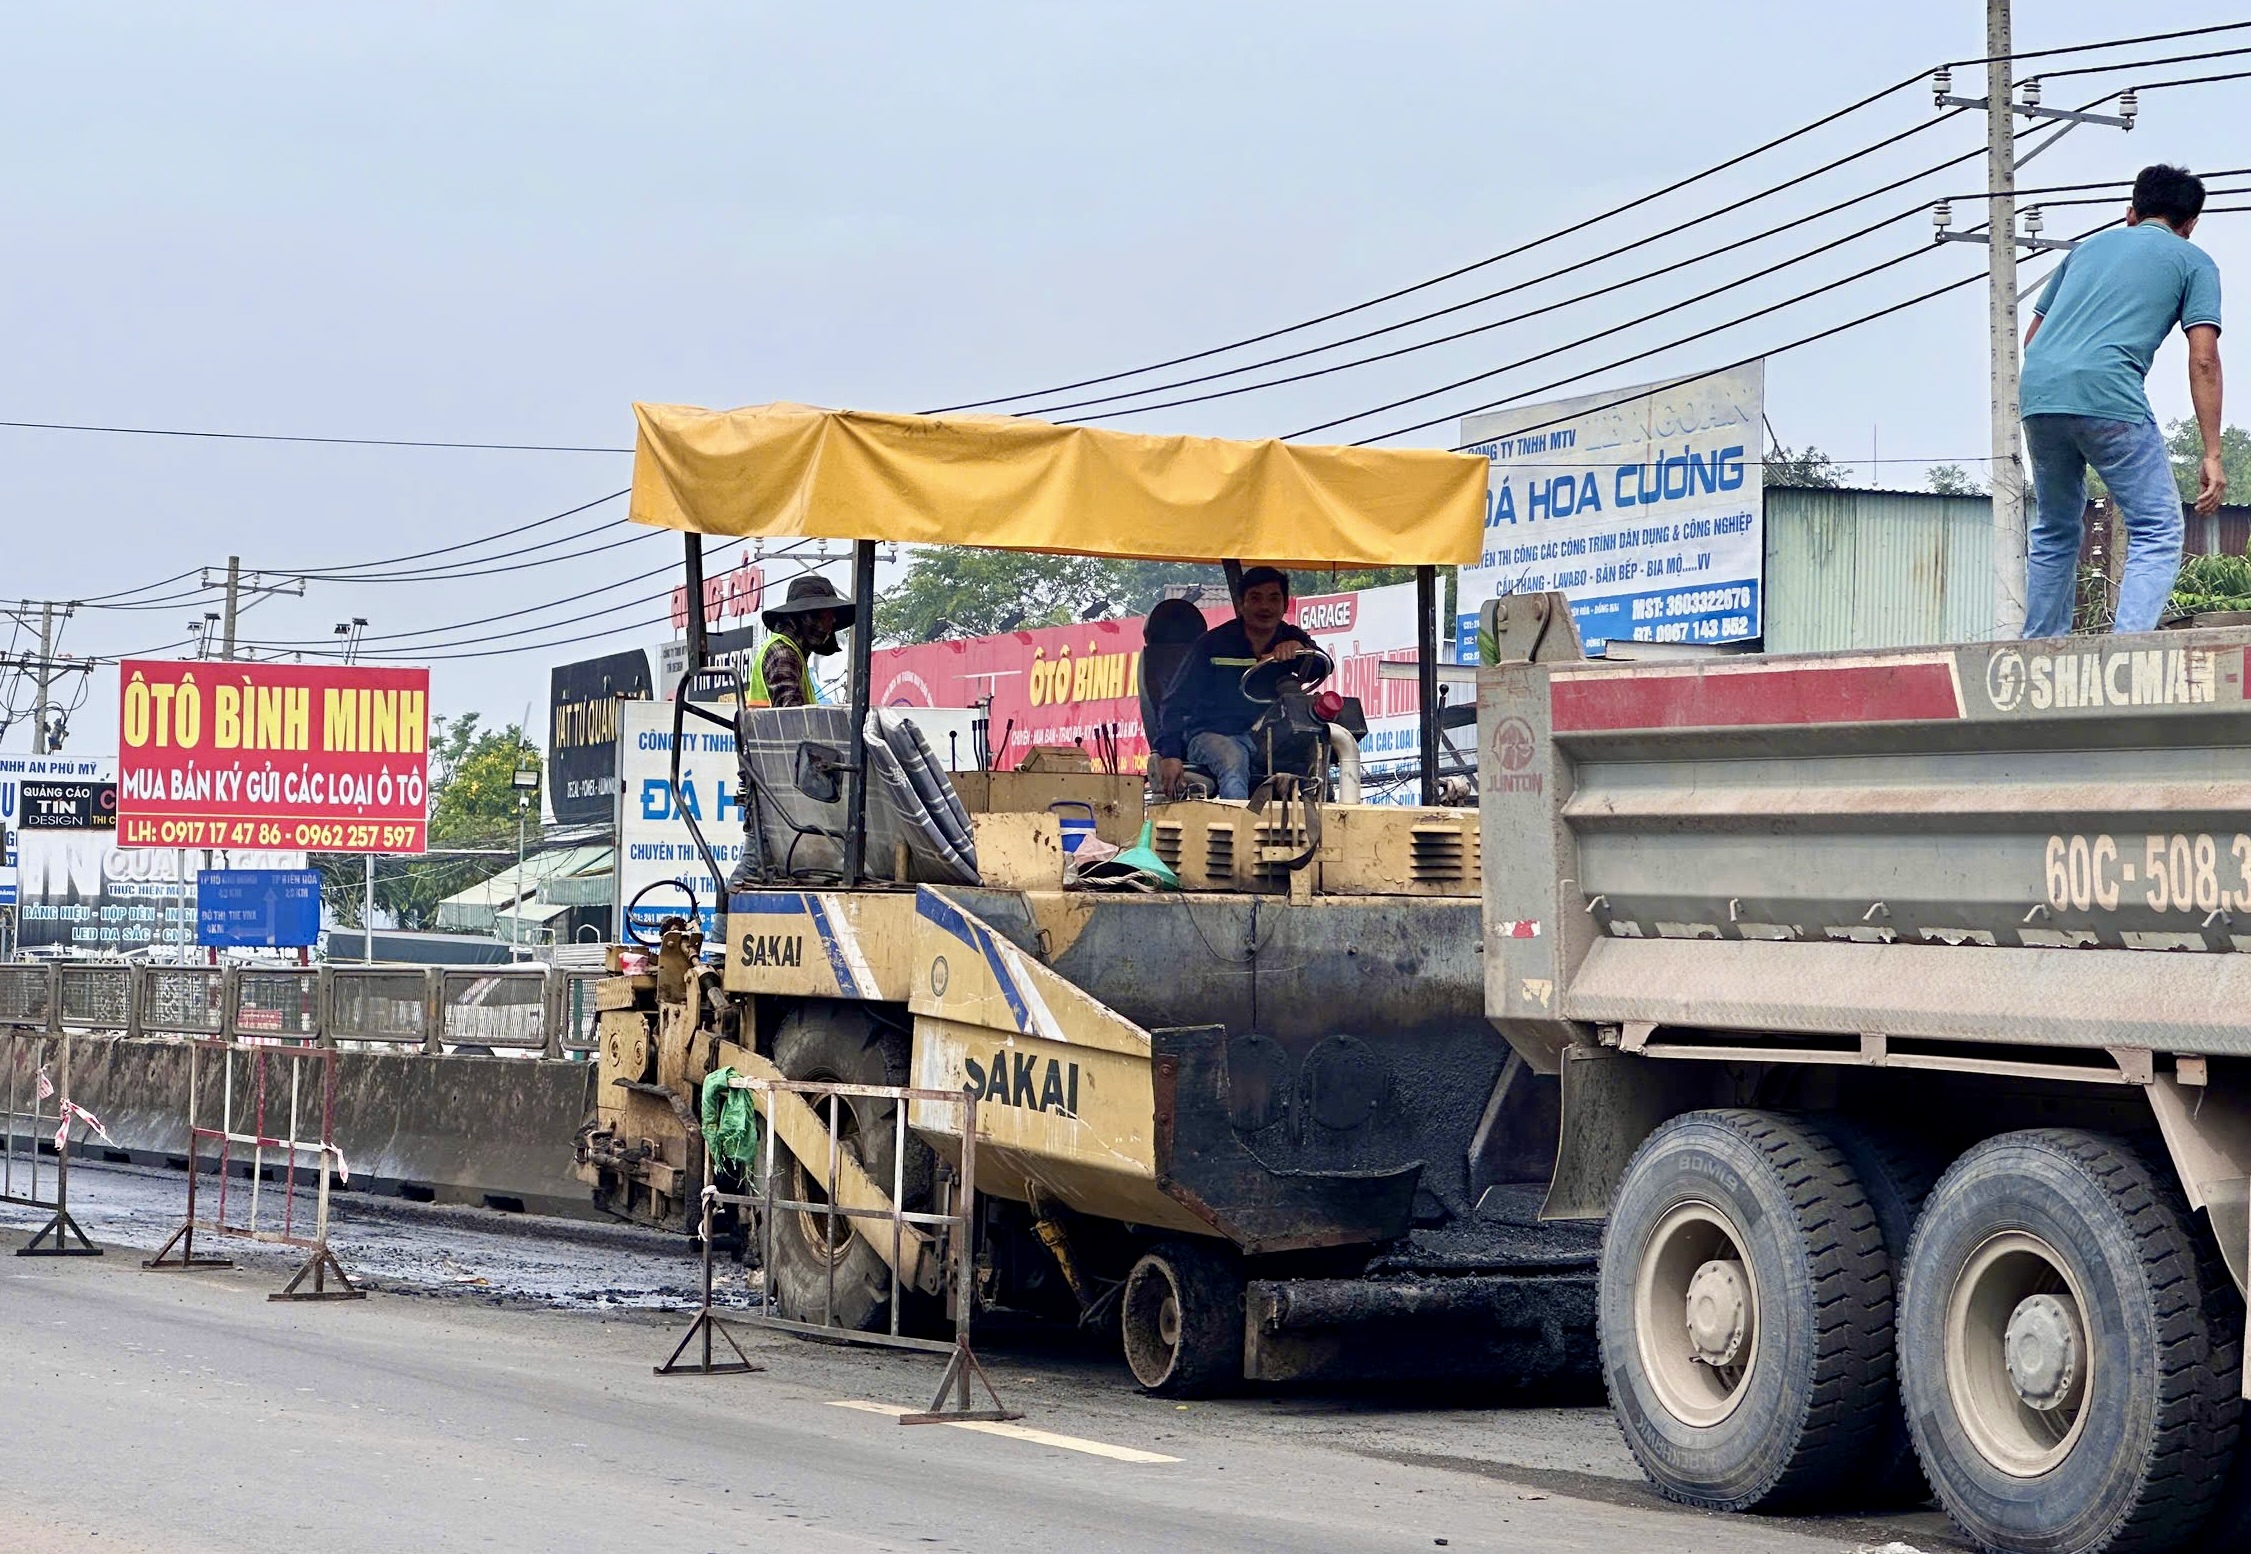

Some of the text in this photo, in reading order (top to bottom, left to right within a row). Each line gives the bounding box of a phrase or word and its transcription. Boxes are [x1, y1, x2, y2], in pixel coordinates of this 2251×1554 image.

[1501, 440, 1514, 459] TY
[1517, 434, 1547, 456] TNHH
[1550, 429, 1576, 450] MTV
[1528, 471, 1602, 522] HOA
[1615, 444, 1744, 508] CƯƠNG
[1498, 550, 1511, 566] THI
[1514, 544, 1538, 563] CÔNG
[1540, 540, 1558, 559] CÁC
[1561, 536, 1586, 557] CÔNG
[1588, 532, 1617, 553] TRÌNH
[1619, 528, 1640, 547] DÂN
[1643, 525, 1670, 548] DỤNG
[1672, 524, 1680, 542] &
[1683, 518, 1710, 540] CÔNG
[1713, 511, 1752, 536] NGHIỆP
[728, 549, 762, 617] CÁO
[1553, 569, 1587, 590] LAVABO
[1596, 562, 1616, 584] BÀN
[1619, 557, 1637, 579] BẾP
[1646, 559, 1664, 578] BIA
[1300, 601, 1351, 630] GARAGE
[1632, 597, 1663, 620] MST:
[1692, 618, 1719, 638] 143
[1721, 616, 1748, 636] 552
[1030, 644, 1072, 707] ÔTÔ
[1072, 640, 1127, 702] BÌNH
[2030, 649, 2216, 710] SHACMAN
[124, 670, 424, 753] ÔTÔ BÌNH MINH
[556, 690, 573, 760] VẬT
[681, 733, 697, 752] TY
[1376, 729, 1392, 752] CÁC
[1395, 728, 1415, 753] LOẠI
[29, 762, 46, 773] AN
[78, 761, 97, 775] MỸ
[23, 784, 90, 798] QUẢNG CÁO
[122, 760, 423, 814] MUA BÁN KÝ GỬI CÁC LOẠI Ô TÔ
[640, 769, 702, 821] ĐÁ
[28, 815, 83, 826] DESIGN
[92, 816, 106, 825] THI
[127, 820, 157, 842] LH:
[161, 821, 205, 843] 0917
[209, 822, 227, 844] 17
[231, 823, 254, 845] 47
[258, 823, 281, 845] 86
[295, 824, 343, 847] 0962
[347, 825, 379, 847] 257
[383, 826, 416, 848] 597
[630, 840, 673, 861] CHUYÊN
[677, 843, 694, 860] THI
[108, 883, 135, 896] THỰC
[23, 902, 57, 921] BẢNG
[60, 904, 90, 923] HIỆU
[101, 904, 126, 924] HỘP
[128, 905, 155, 921] ĐÈN
[72, 927, 99, 940] LED
[100, 927, 119, 941] ĐA
[123, 924, 150, 941] SẮC
[741, 933, 803, 967] SAKAI
[963, 1049, 1079, 1120] SAKAI
